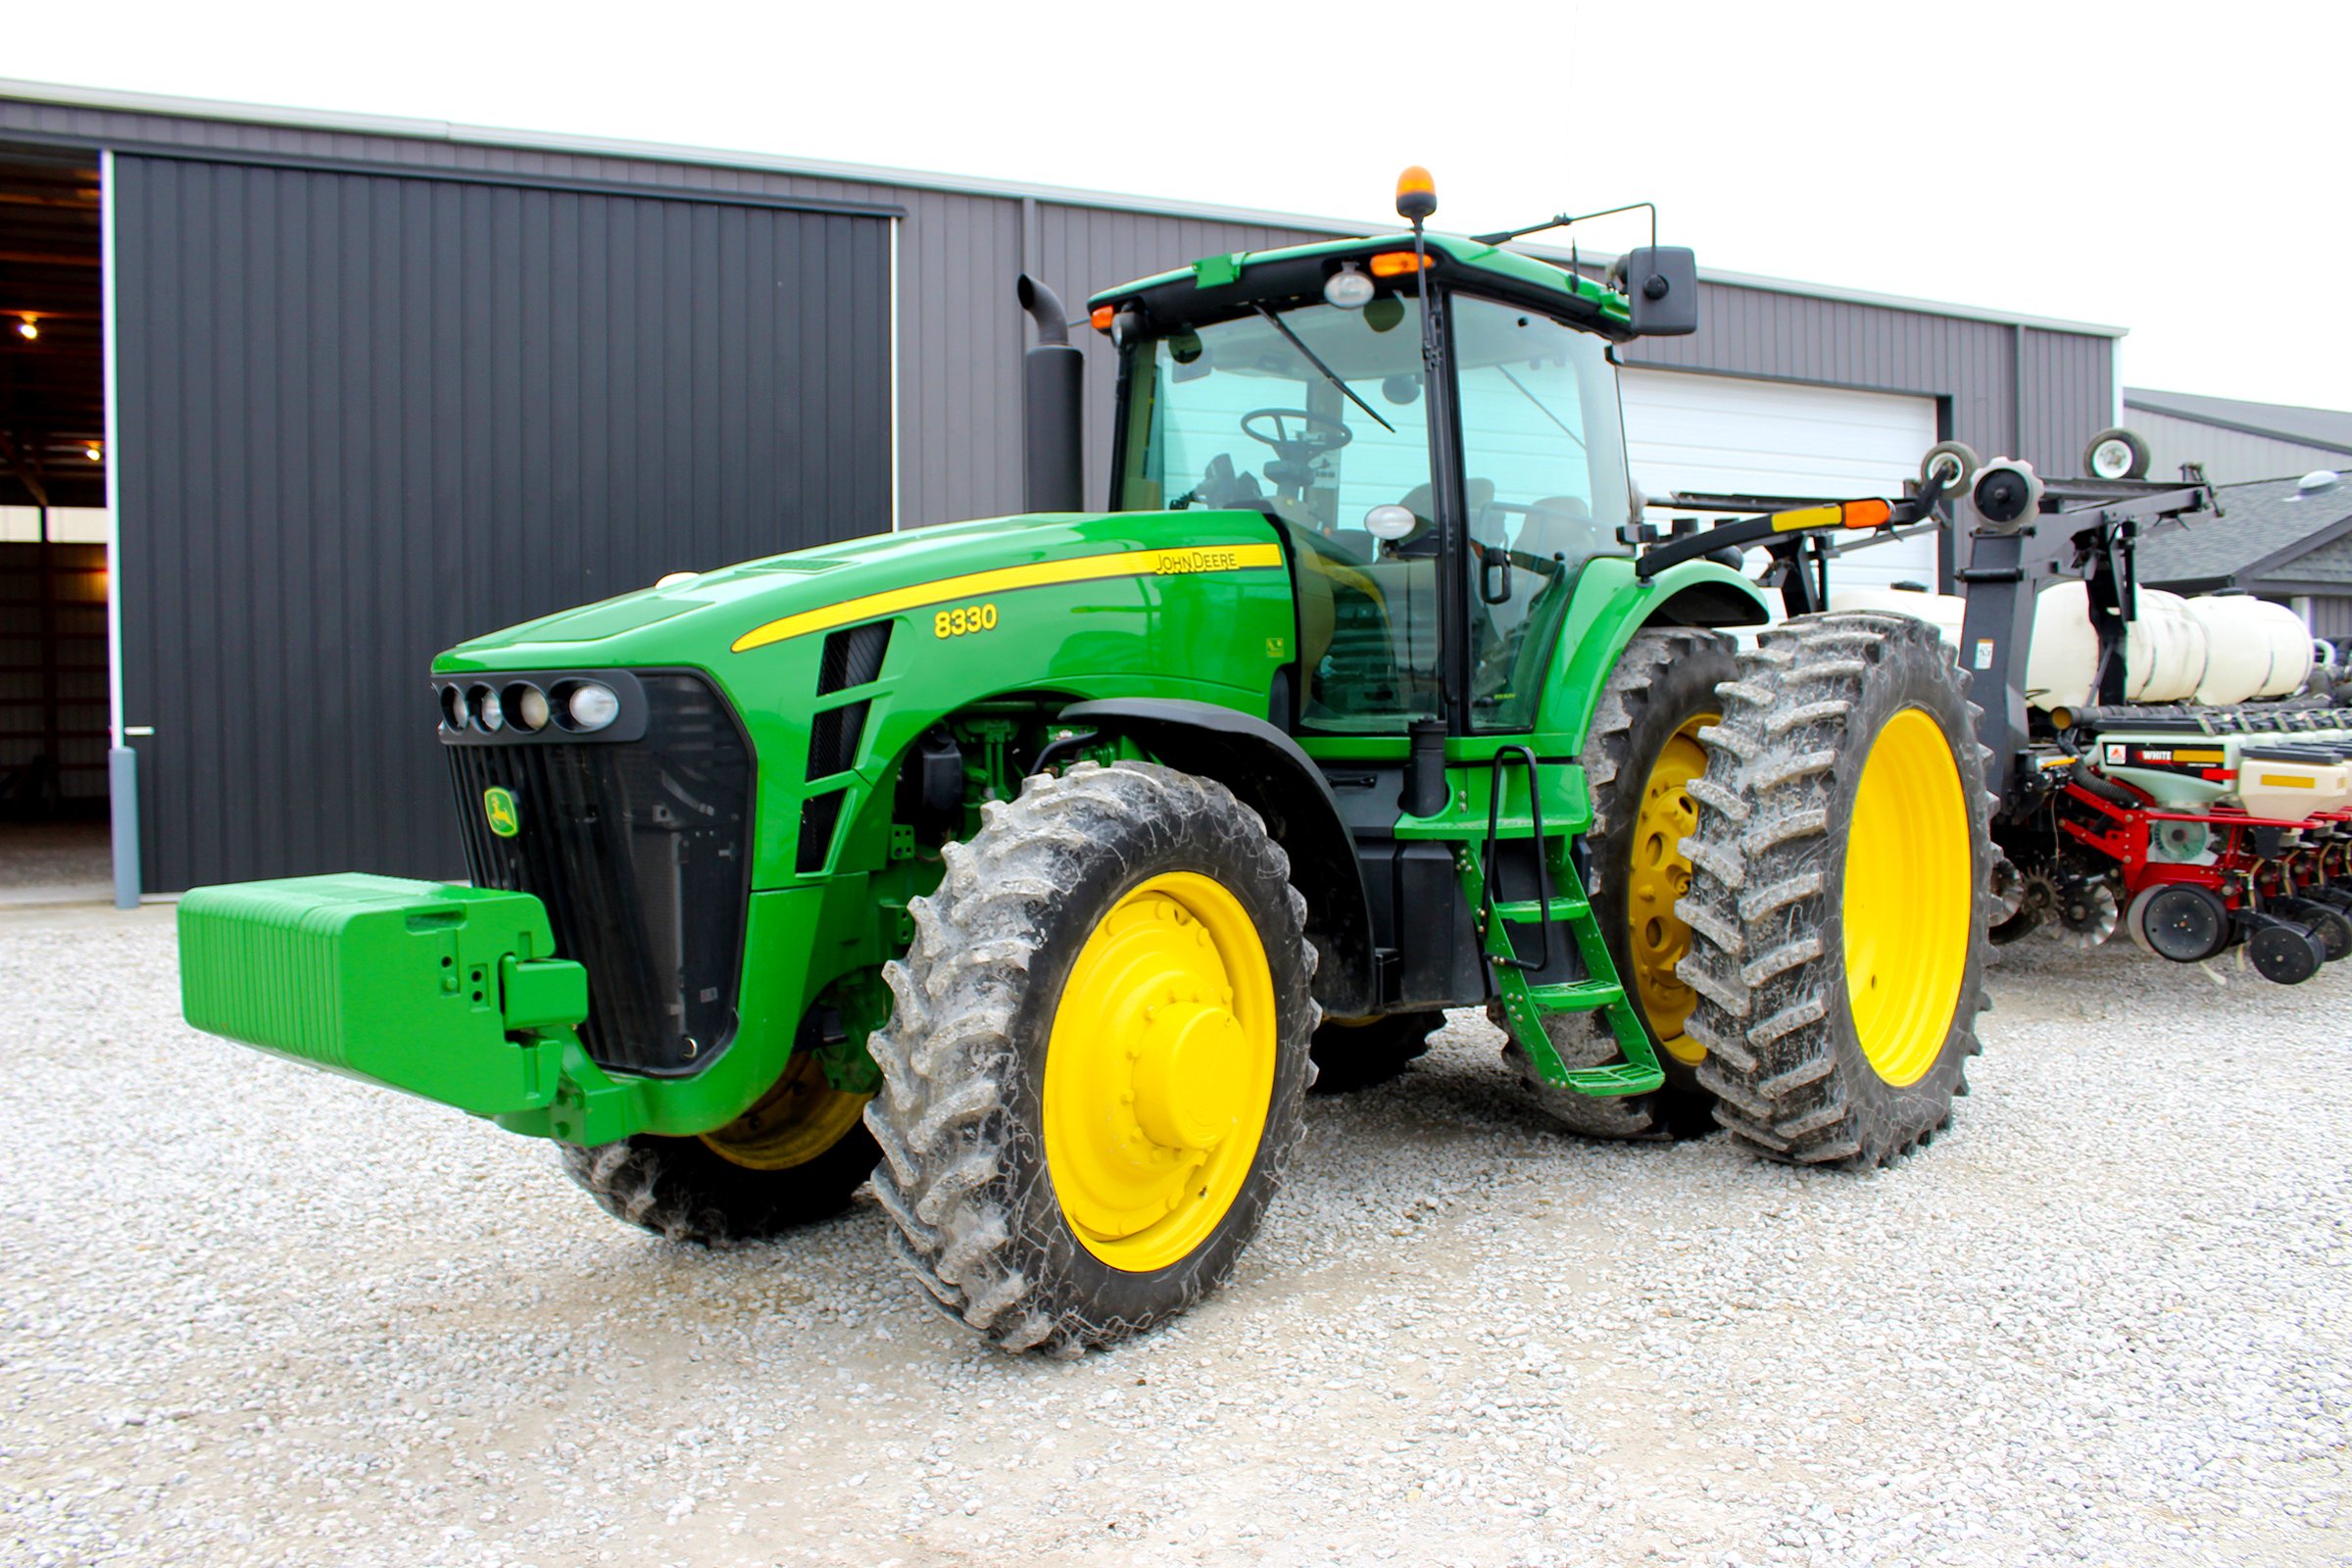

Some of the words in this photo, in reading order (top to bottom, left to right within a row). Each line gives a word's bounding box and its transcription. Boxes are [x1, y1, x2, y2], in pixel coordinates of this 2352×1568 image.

[1155, 554, 1192, 571] JOHN
[1192, 552, 1238, 568] DEERE
[934, 603, 998, 638] 8330
[2142, 750, 2172, 761] WHITE
